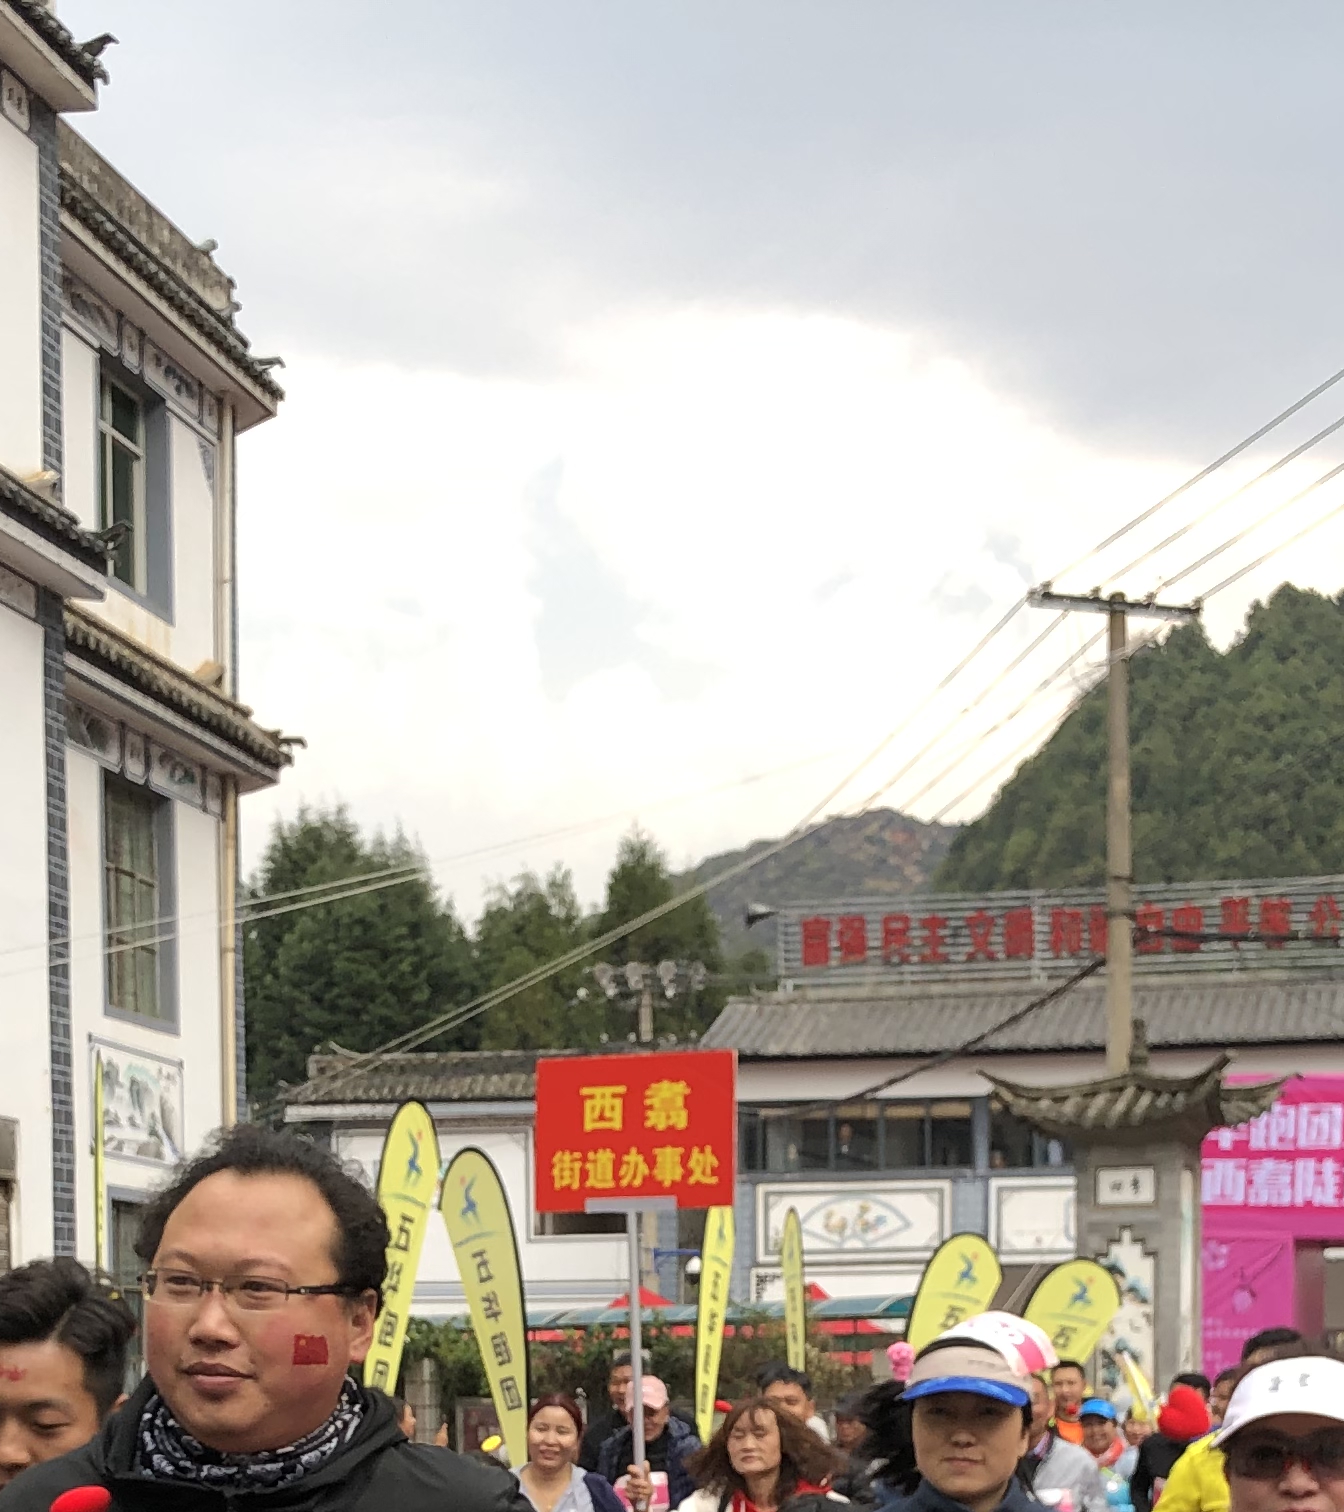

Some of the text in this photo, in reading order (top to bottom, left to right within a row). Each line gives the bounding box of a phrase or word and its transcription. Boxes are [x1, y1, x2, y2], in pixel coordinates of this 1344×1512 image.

[552, 1145, 720, 1191] 街道办事处
